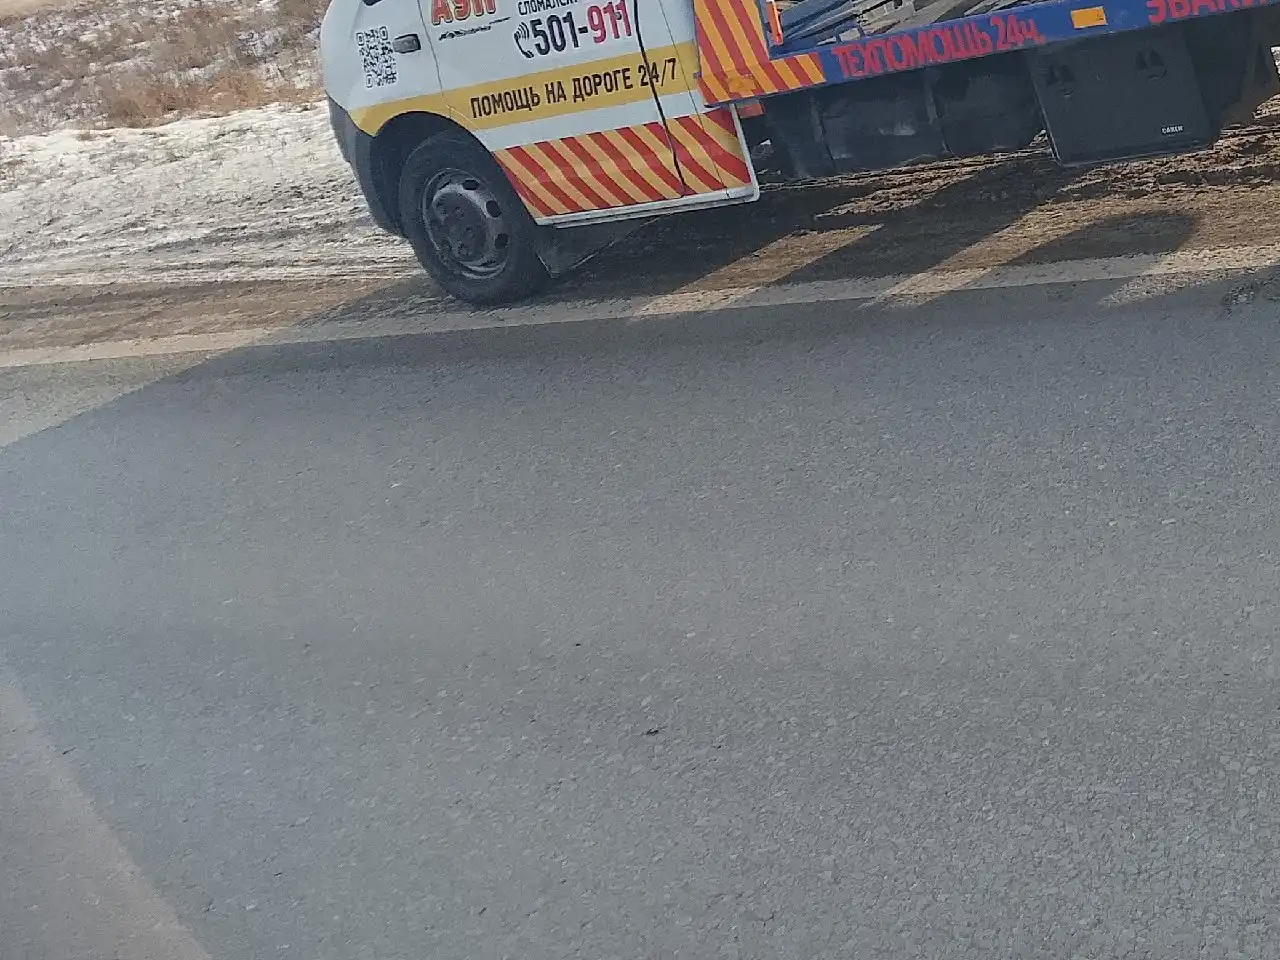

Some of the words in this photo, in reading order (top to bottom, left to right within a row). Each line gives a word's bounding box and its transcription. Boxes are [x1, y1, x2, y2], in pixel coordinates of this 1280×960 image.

[831, 23, 993, 78] ТЕХПОМОЩЬ
[470, 86, 541, 118] ПОМОЩЬ
[544, 80, 567, 104] НА
[571, 67, 633, 103] ДОРОГЕ
[637, 57, 677, 87] 24/7
